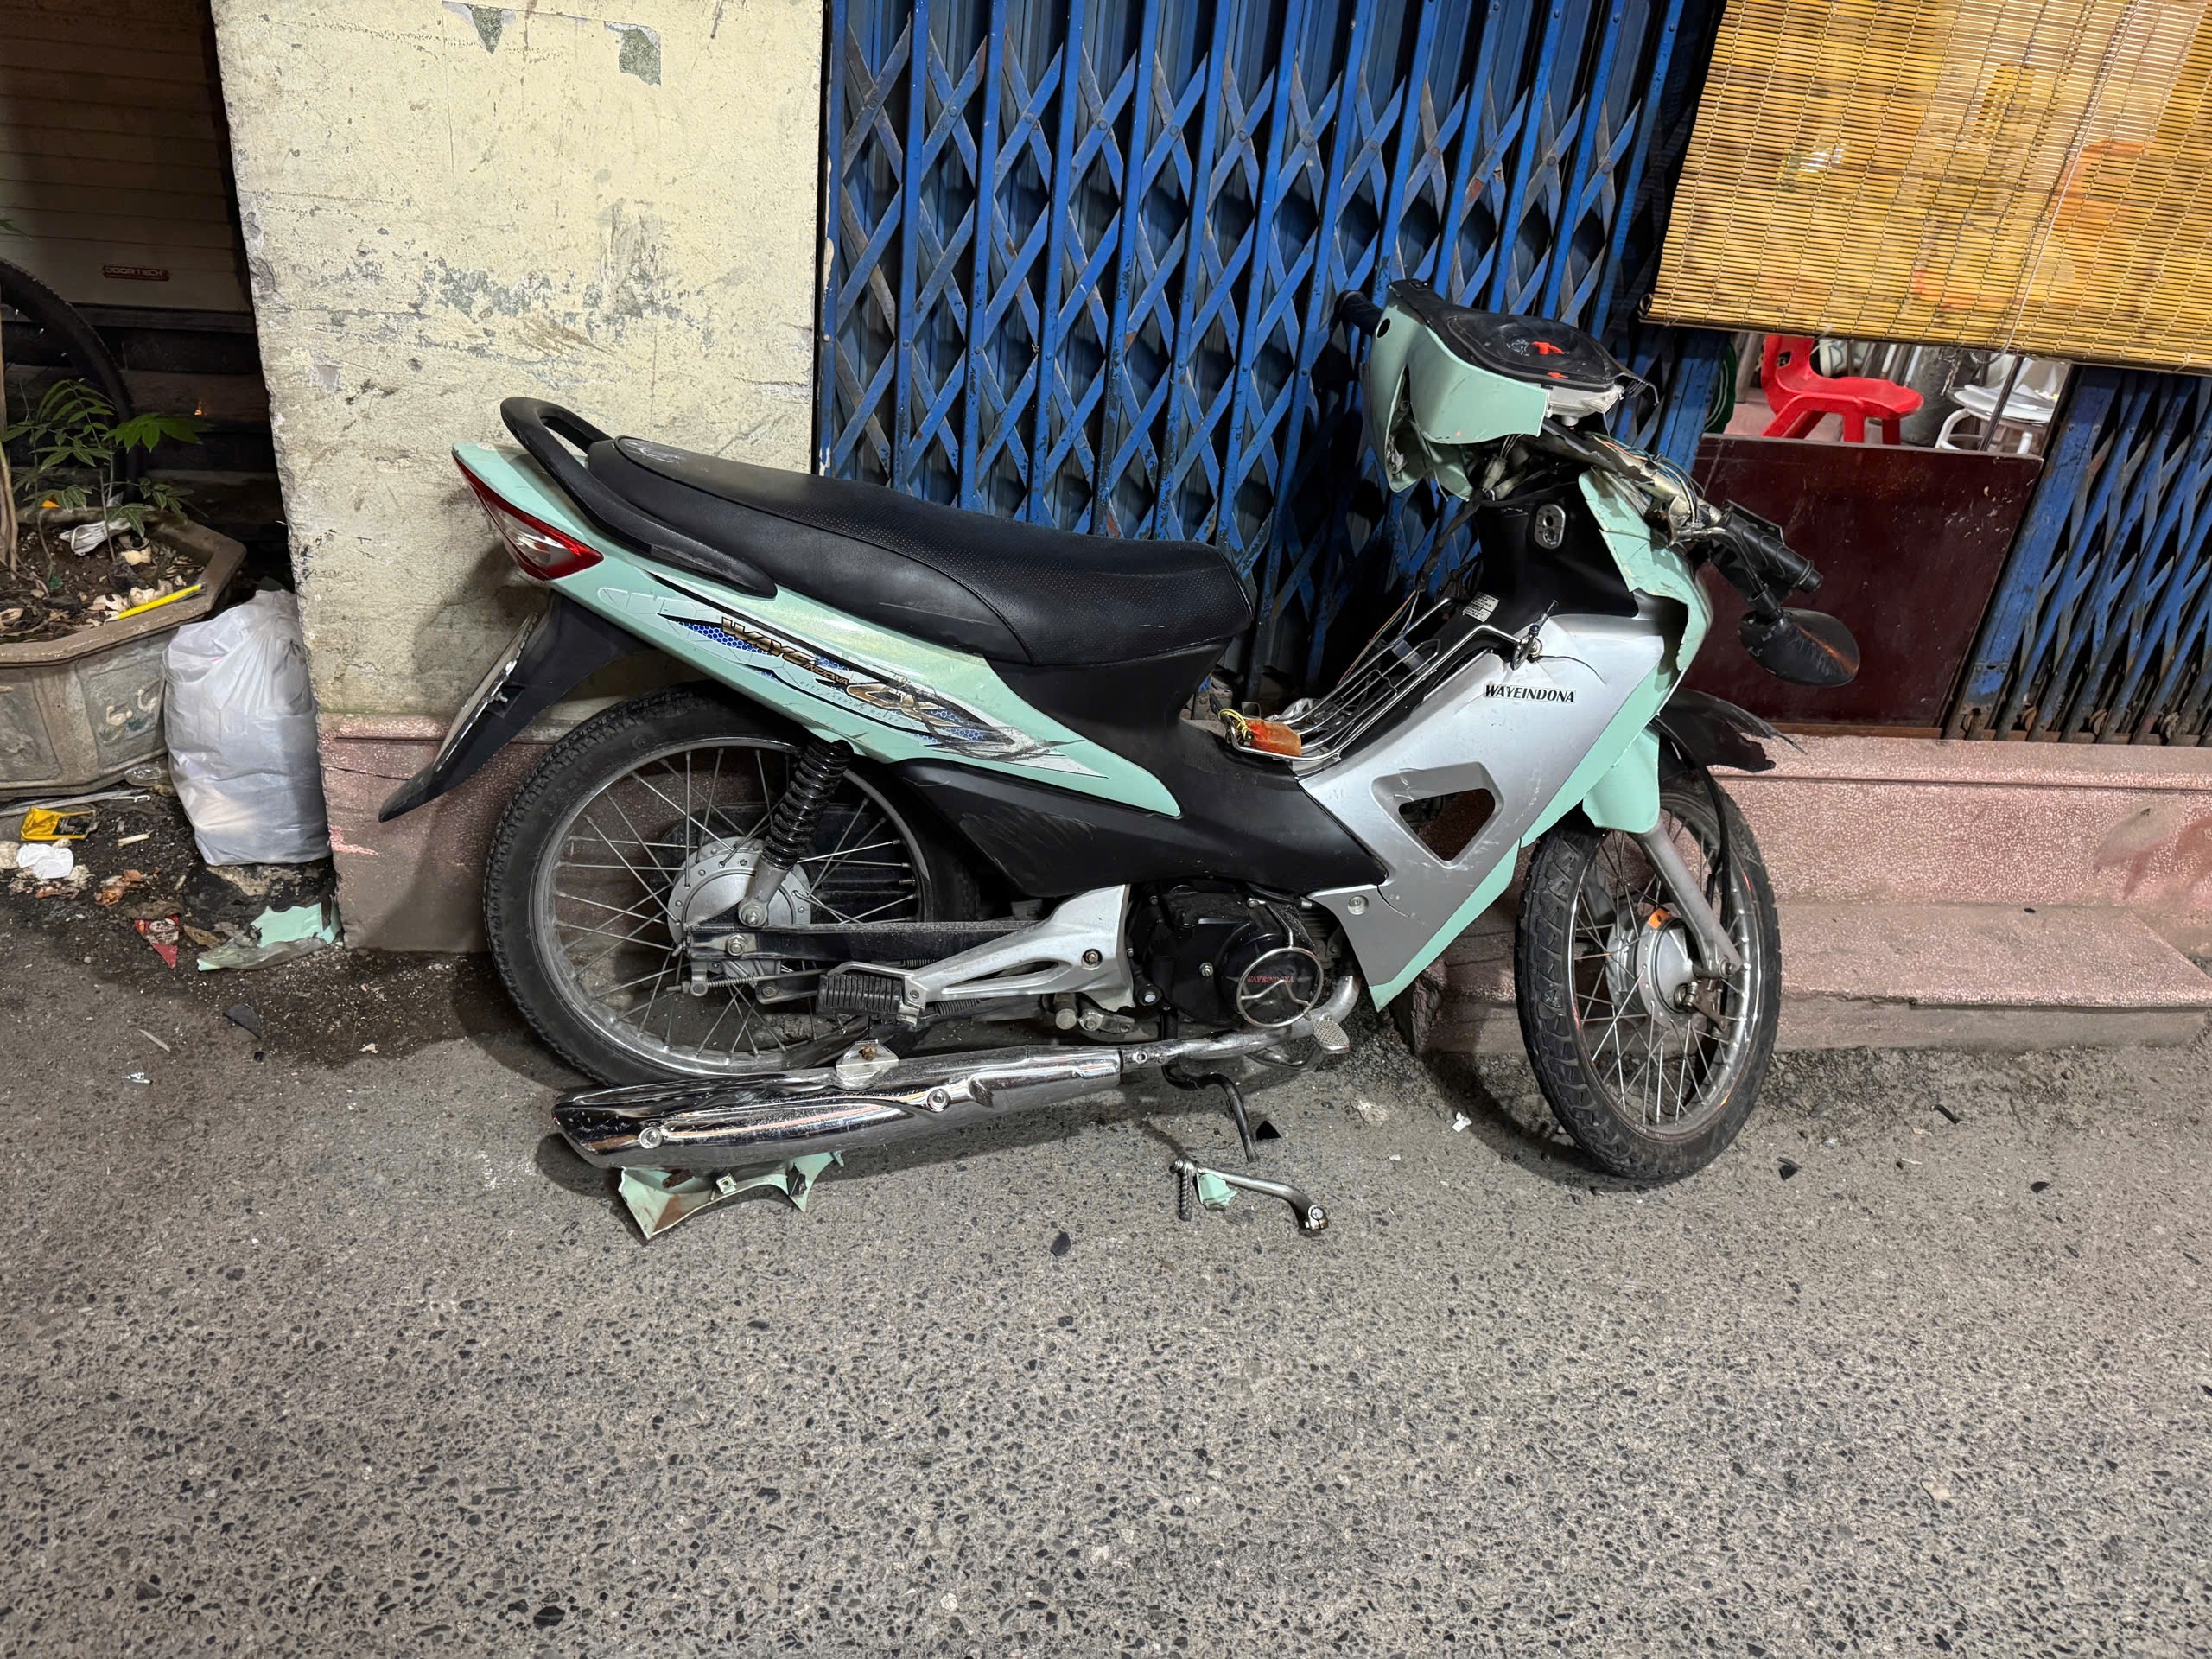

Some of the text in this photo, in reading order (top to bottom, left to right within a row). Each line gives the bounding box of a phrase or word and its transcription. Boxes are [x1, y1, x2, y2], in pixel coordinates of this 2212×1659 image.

[803, 662, 849, 686] INDONA
[800, 681, 821, 691] CITY
[1485, 684, 1574, 702] WAYEINDONA
